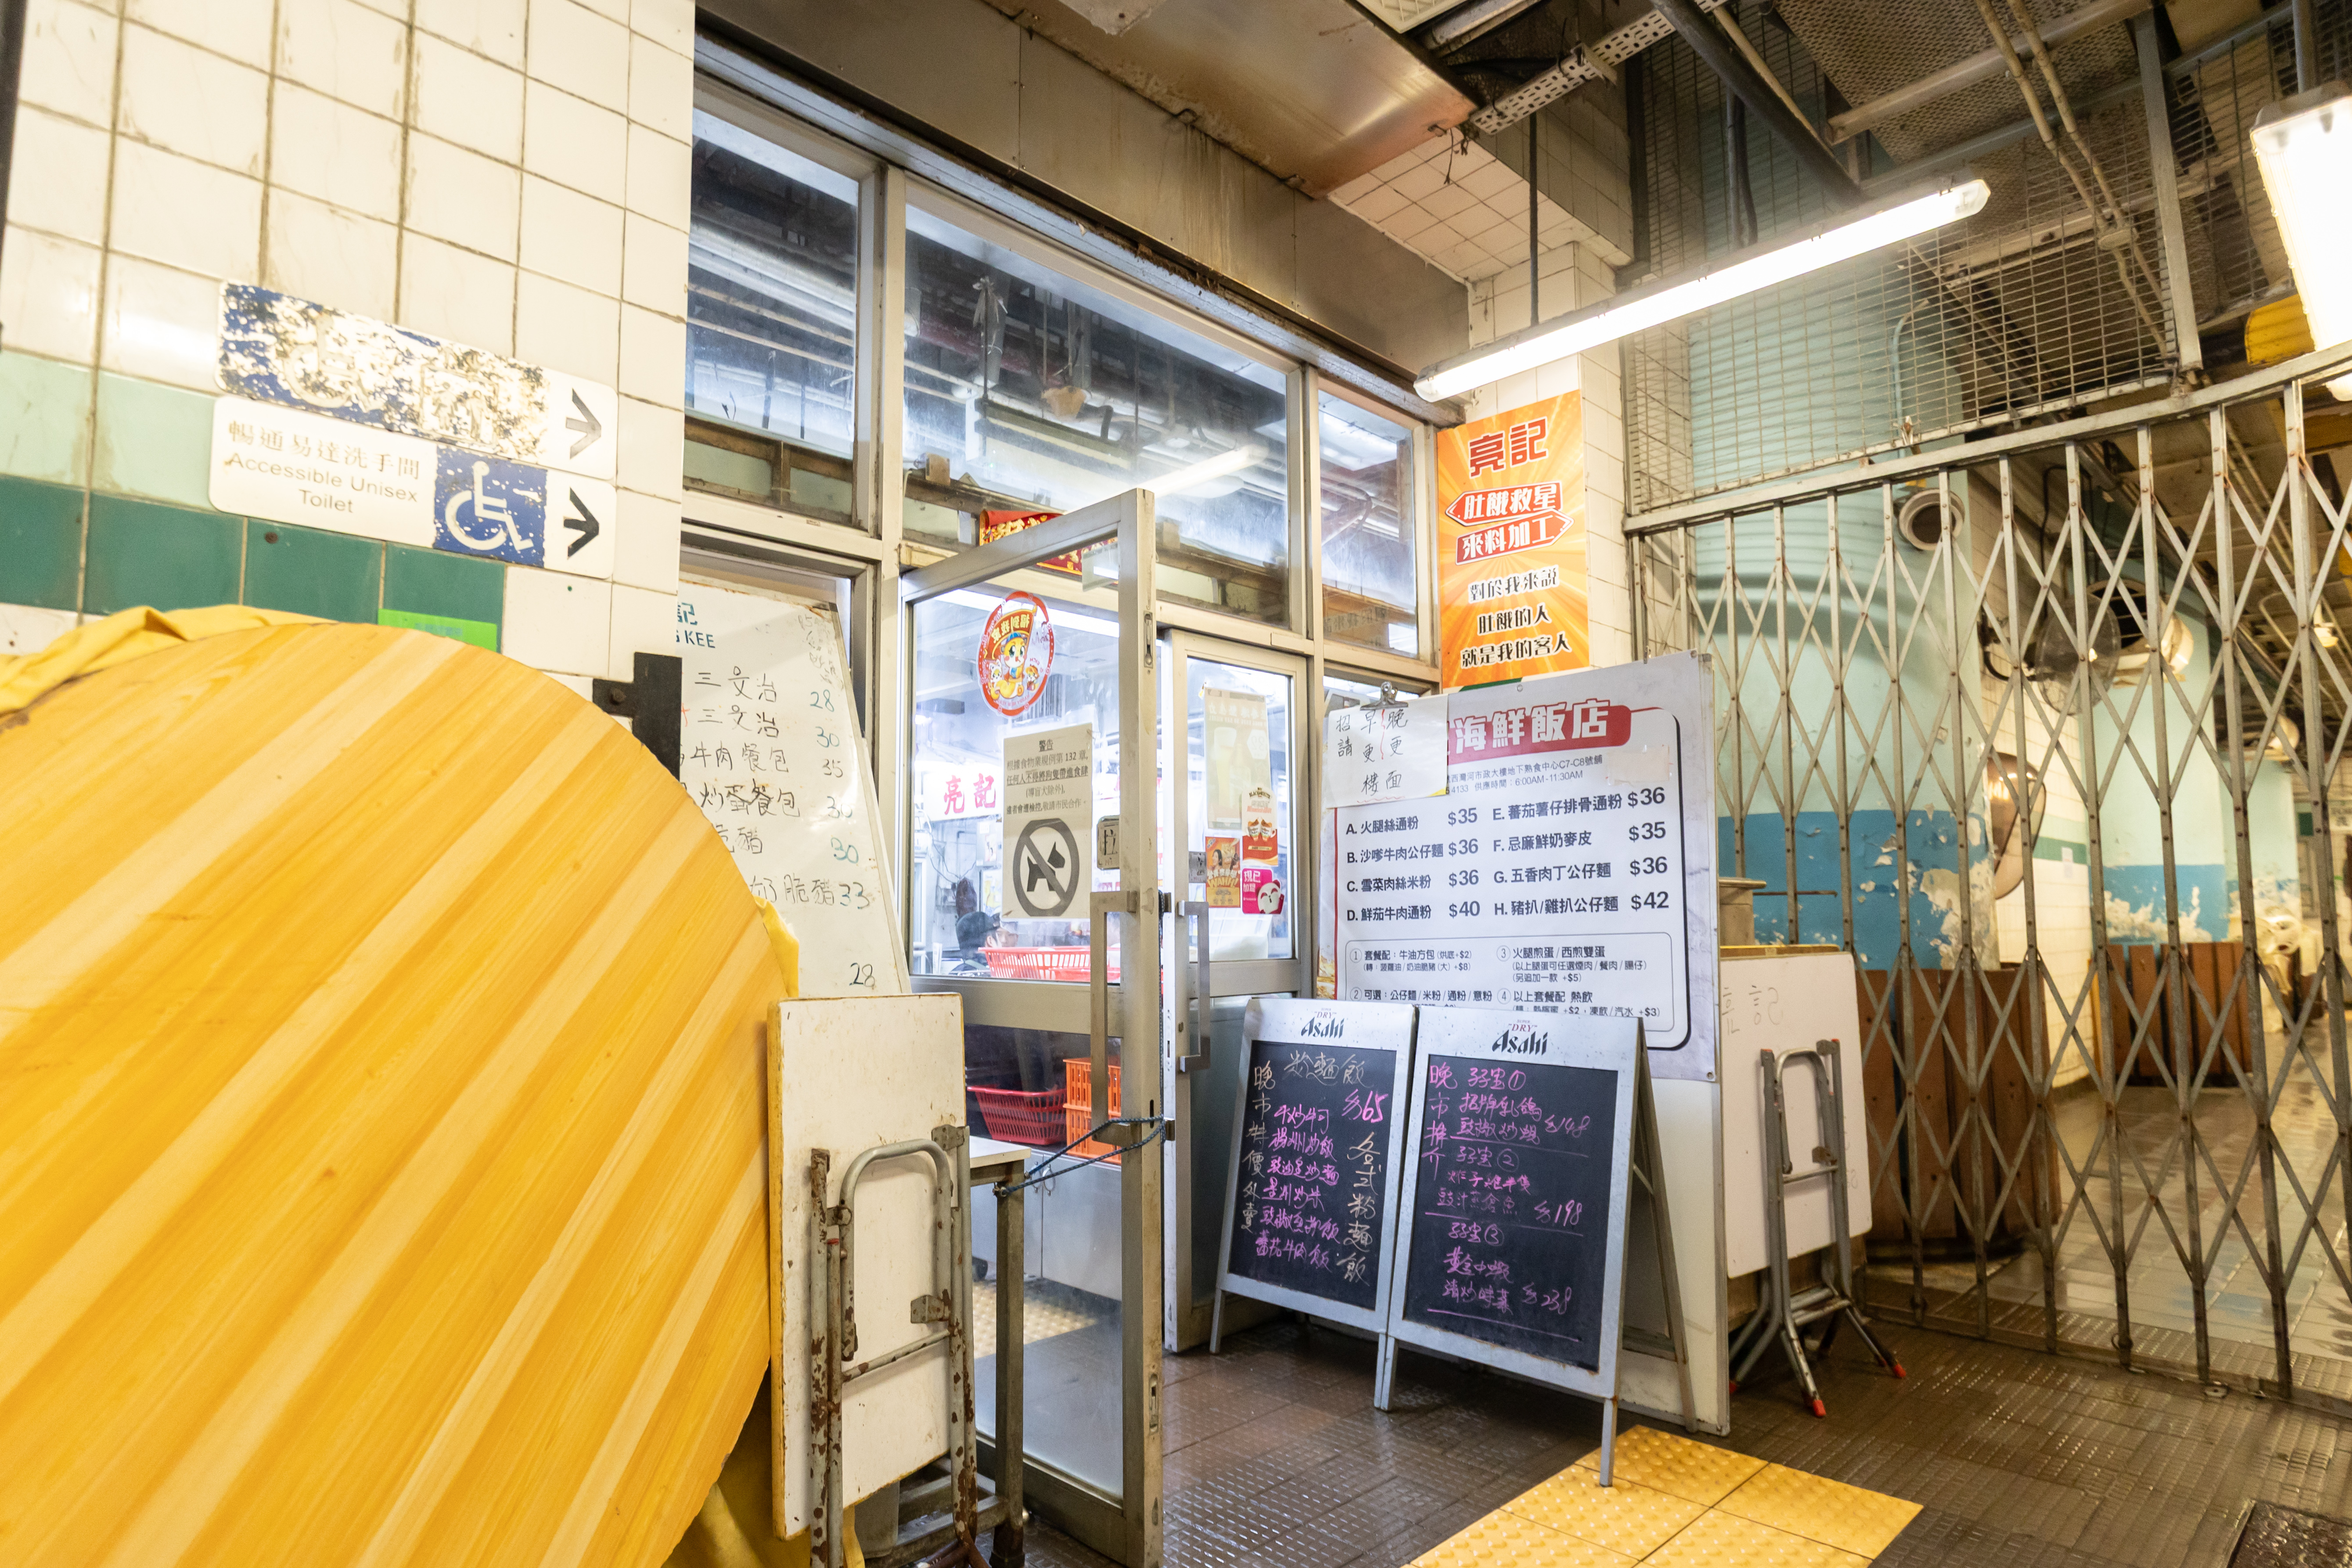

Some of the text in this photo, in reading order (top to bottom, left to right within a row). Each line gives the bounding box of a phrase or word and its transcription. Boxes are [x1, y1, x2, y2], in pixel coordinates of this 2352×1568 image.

[228, 421, 419, 479] 暢通易達洗手間
[1468, 417, 1548, 478] 亮記
[230, 453, 417, 502] Accessible Unisex
[299, 489, 353, 513] Toilet
[1464, 484, 1557, 519] 肚餓救星
[1463, 513, 1555, 560] 來料加工
[1478, 603, 1550, 634] 肚餓的人
[685, 630, 715, 648] KEE
[1461, 633, 1571, 668] 就是我的客人
[810, 690, 834, 712] 28
[816, 726, 839, 747] 30
[1454, 698, 1610, 755] 海鮮飯店
[1039, 739, 1053, 752] 警告
[1065, 752, 1076, 762] 132
[680, 741, 843, 778] 牛肉餐包 35
[680, 778, 852, 818] 炒蛋餐包 30
[1452, 784, 1468, 794] 4133
[1493, 808, 1504, 820] E.
[1628, 787, 1665, 809] $36
[1346, 808, 1478, 834] A. 火腿絲通粉 $35
[1493, 821, 1666, 852] F. 忌廉鮮奶麥皮 $35
[831, 838, 858, 863] 30
[1347, 852, 1358, 863] B.
[1449, 838, 1478, 857] $36
[1244, 870, 1261, 883] 現已
[1347, 870, 1479, 892] C. 雪菜肉絲米粉 $36
[1494, 871, 1507, 883] G.
[1630, 856, 1668, 877] $36
[839, 882, 870, 909] 33
[1494, 903, 1507, 915] H.
[1631, 891, 1669, 911] $42
[1347, 901, 1480, 921] D. 鮮茄牛肉通粉 $40
[849, 963, 875, 987] 28
[1301, 1017, 1344, 1039] Asahi
[1492, 1029, 1548, 1055] Asahi
